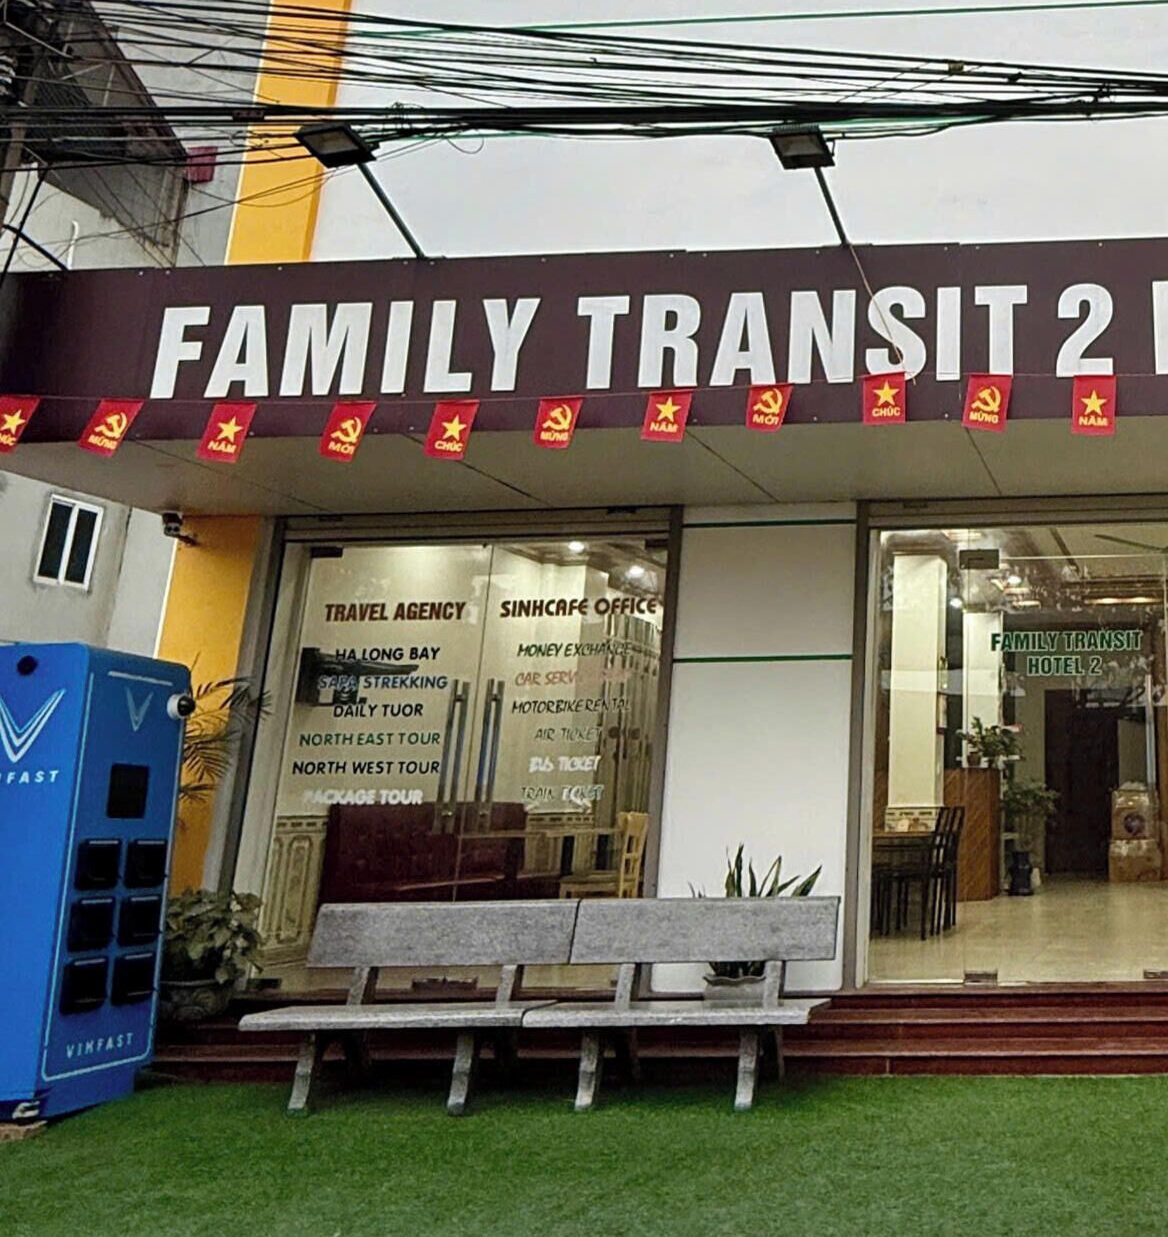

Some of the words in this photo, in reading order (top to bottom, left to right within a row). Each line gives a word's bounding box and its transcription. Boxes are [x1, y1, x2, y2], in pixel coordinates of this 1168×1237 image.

[150, 297, 540, 399] FAMILY
[576, 284, 1028, 389] TRANSIT
[1056, 283, 1114, 378] 2
[324, 603, 389, 622] TRAVEL
[393, 601, 467, 620] AGENCY
[500, 598, 589, 618] SINHCAFE
[594, 597, 657, 615] OFFICE
[991, 631, 1059, 652] FAMILY
[1064, 630, 1144, 652] TRANSIT
[336, 648, 356, 660] HA
[363, 647, 404, 661] LONG
[409, 646, 441, 660] BAY
[517, 642, 564, 657] MONEY
[1027, 655, 1085, 676] HOTEL
[1089, 655, 1102, 676] 2
[363, 675, 448, 690] STREKKING
[333, 704, 378, 718] DAILY
[382, 703, 424, 717] TUOR
[299, 733, 353, 747] NORTH
[357, 732, 393, 746] EAST
[398, 732, 441, 745] TOUR
[292, 761, 347, 775] NORTH
[352, 761, 394, 775] WEST
[398, 761, 441, 775] TOUR
[0, 770, 60, 784] FAST
[379, 789, 424, 805] TOUR
